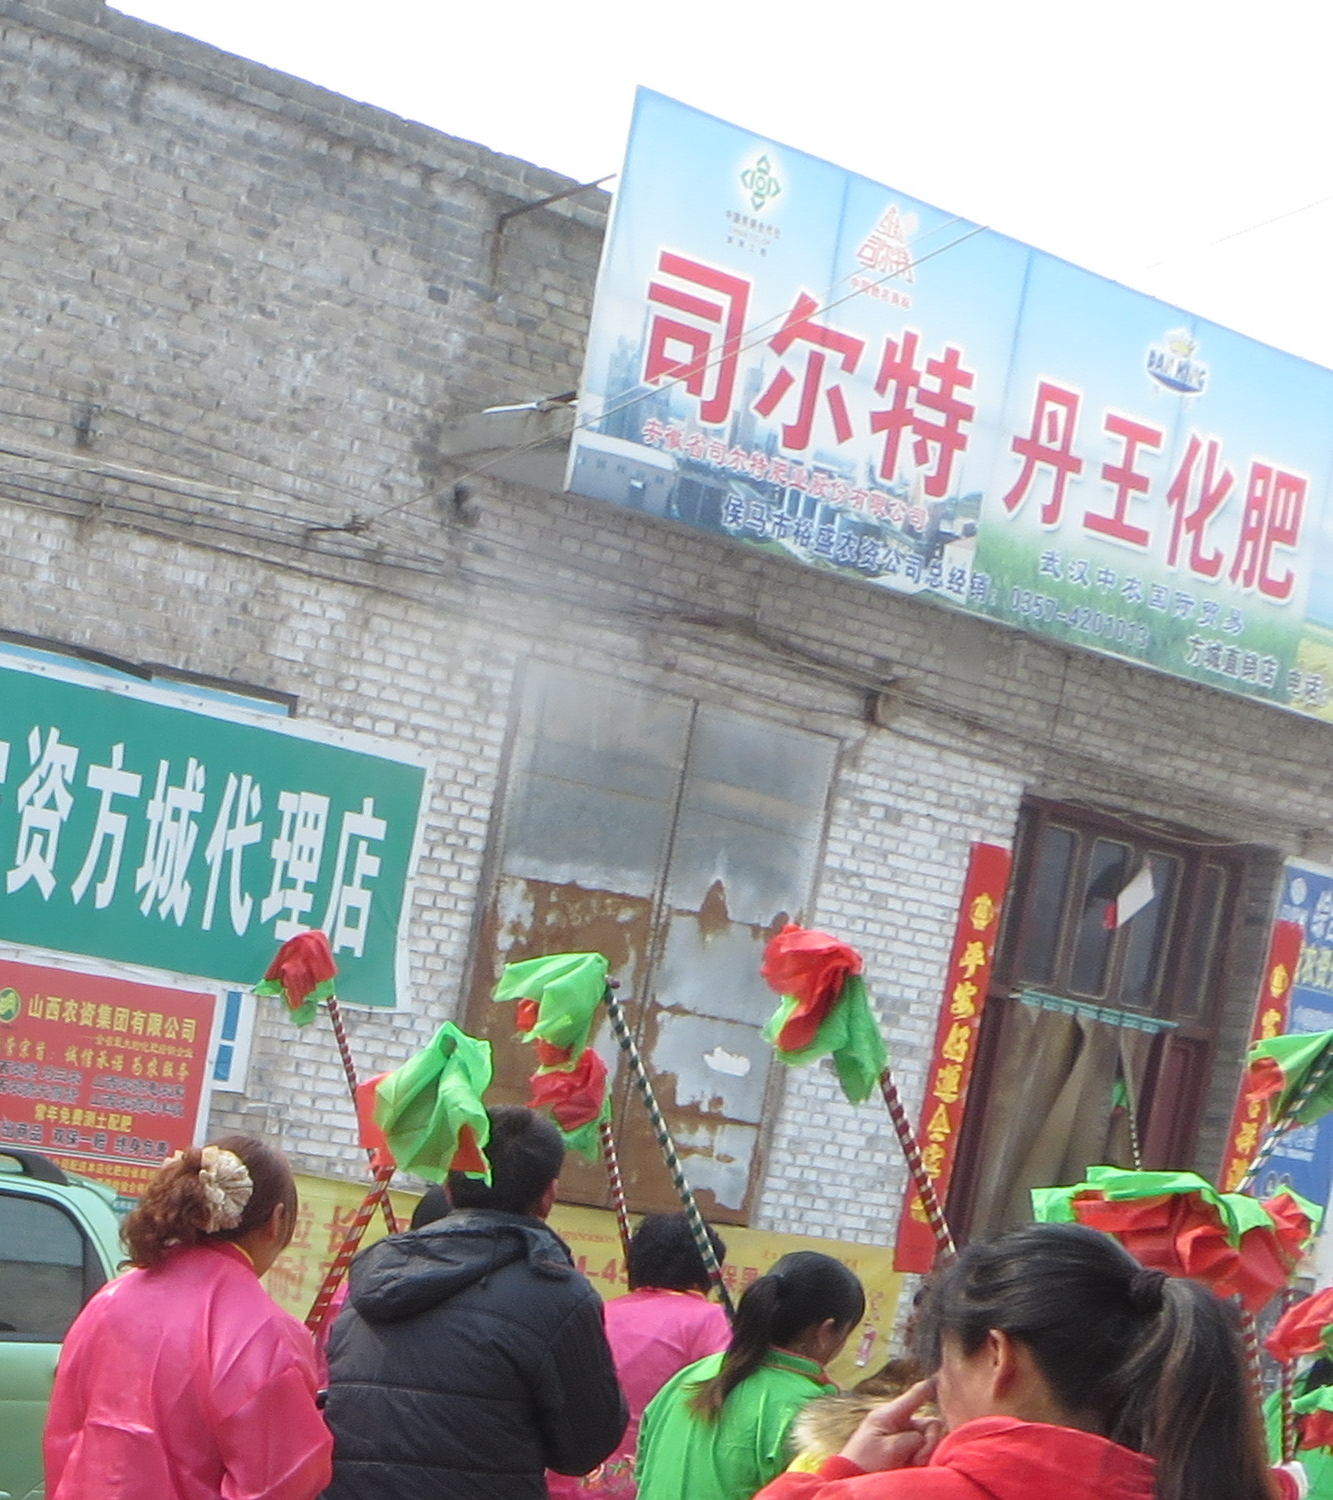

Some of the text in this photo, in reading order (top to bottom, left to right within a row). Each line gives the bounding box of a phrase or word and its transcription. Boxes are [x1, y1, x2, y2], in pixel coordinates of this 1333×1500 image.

[641, 249, 978, 501] 司尔特
[1002, 378, 1310, 602] 丹王化肥
[27, 992, 198, 1043] 山西农资集团有限公司
